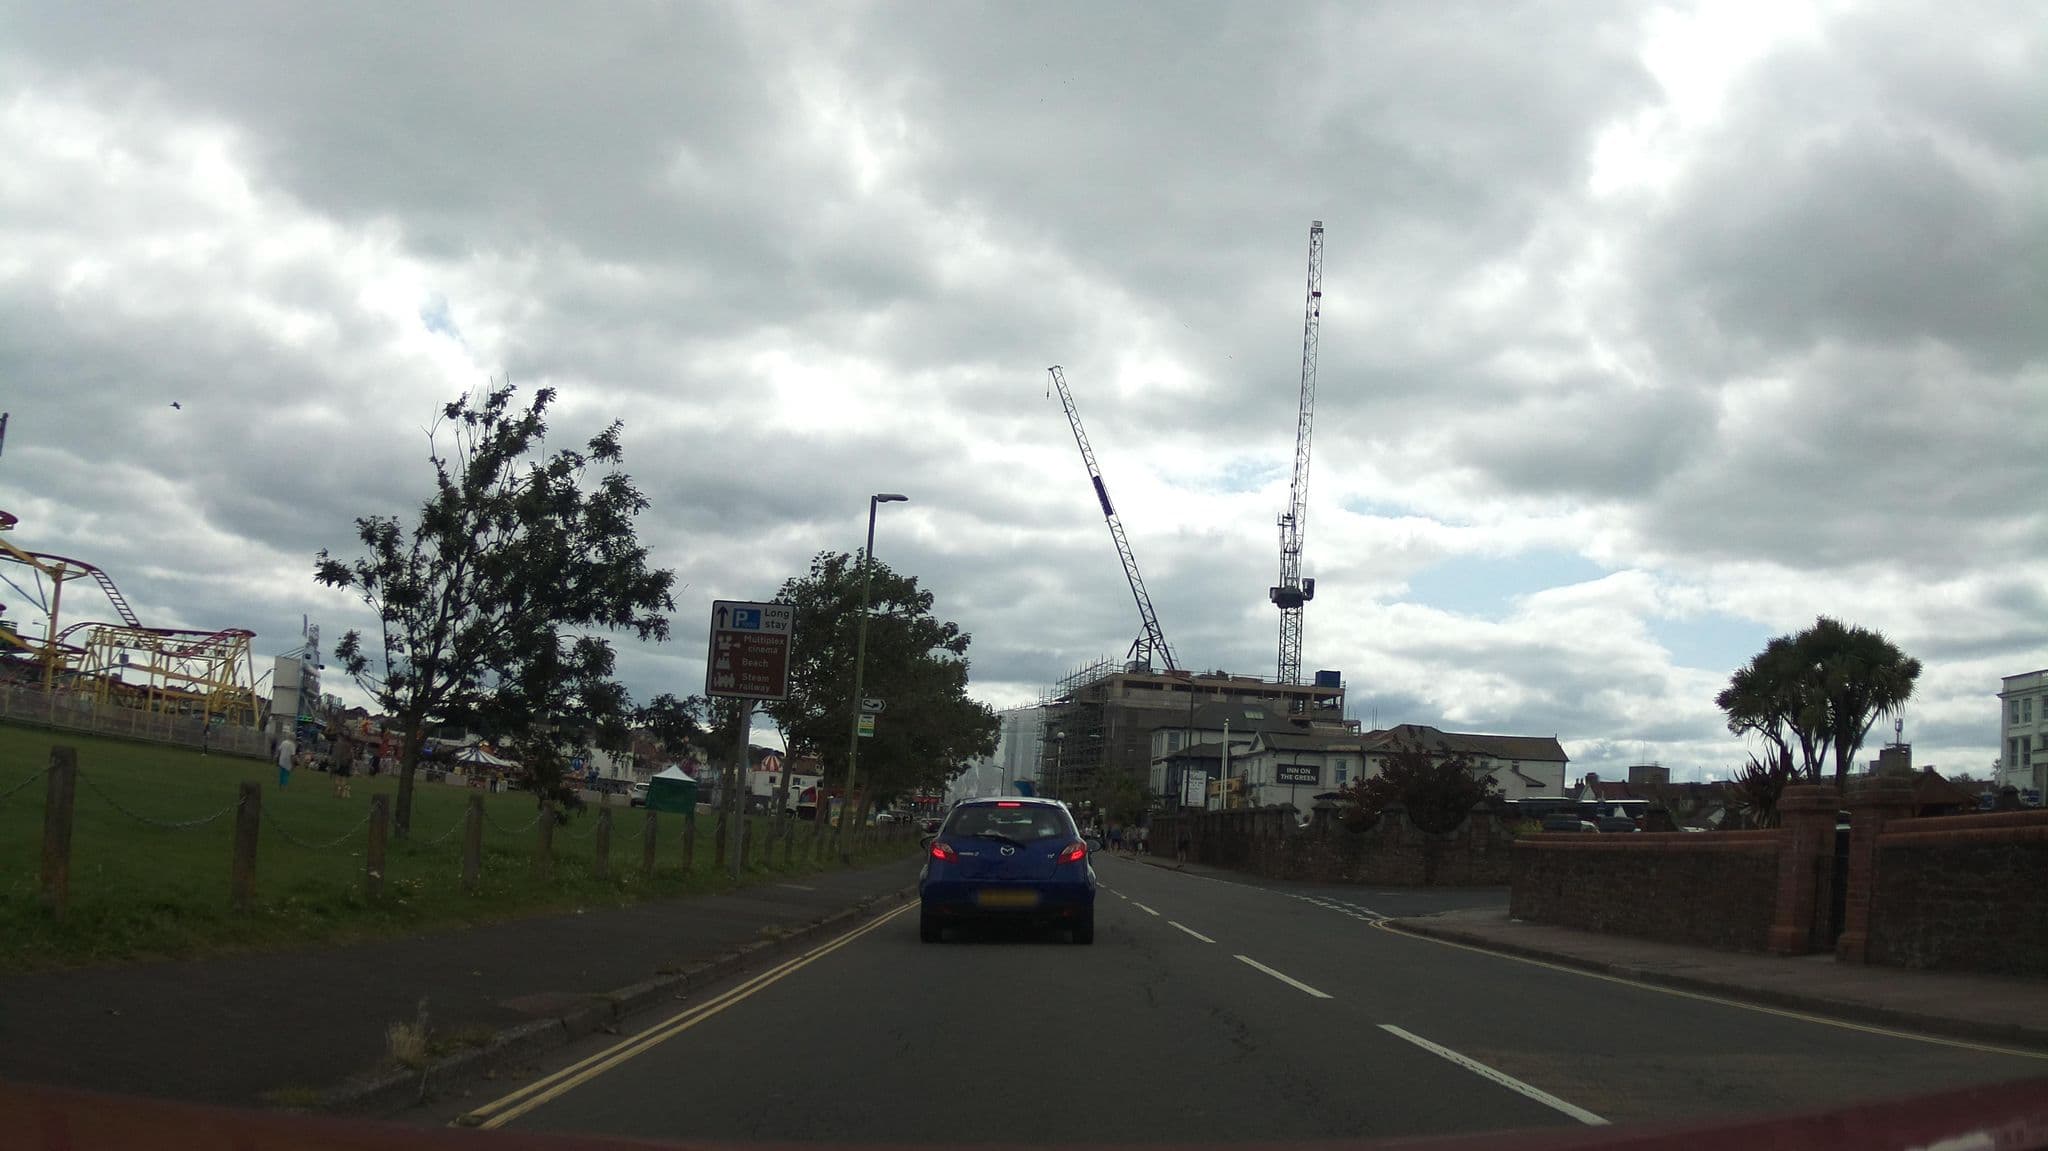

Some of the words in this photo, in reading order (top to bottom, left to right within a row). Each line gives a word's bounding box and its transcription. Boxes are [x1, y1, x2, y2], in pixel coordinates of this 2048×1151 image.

[736, 610, 748, 626] P
[764, 608, 790, 619] Long
[764, 621, 788, 630] stay
[744, 635, 785, 645] Multiplex
[742, 658, 769, 667] Beach
[742, 673, 769, 682] Steam
[739, 683, 770, 692] railway
